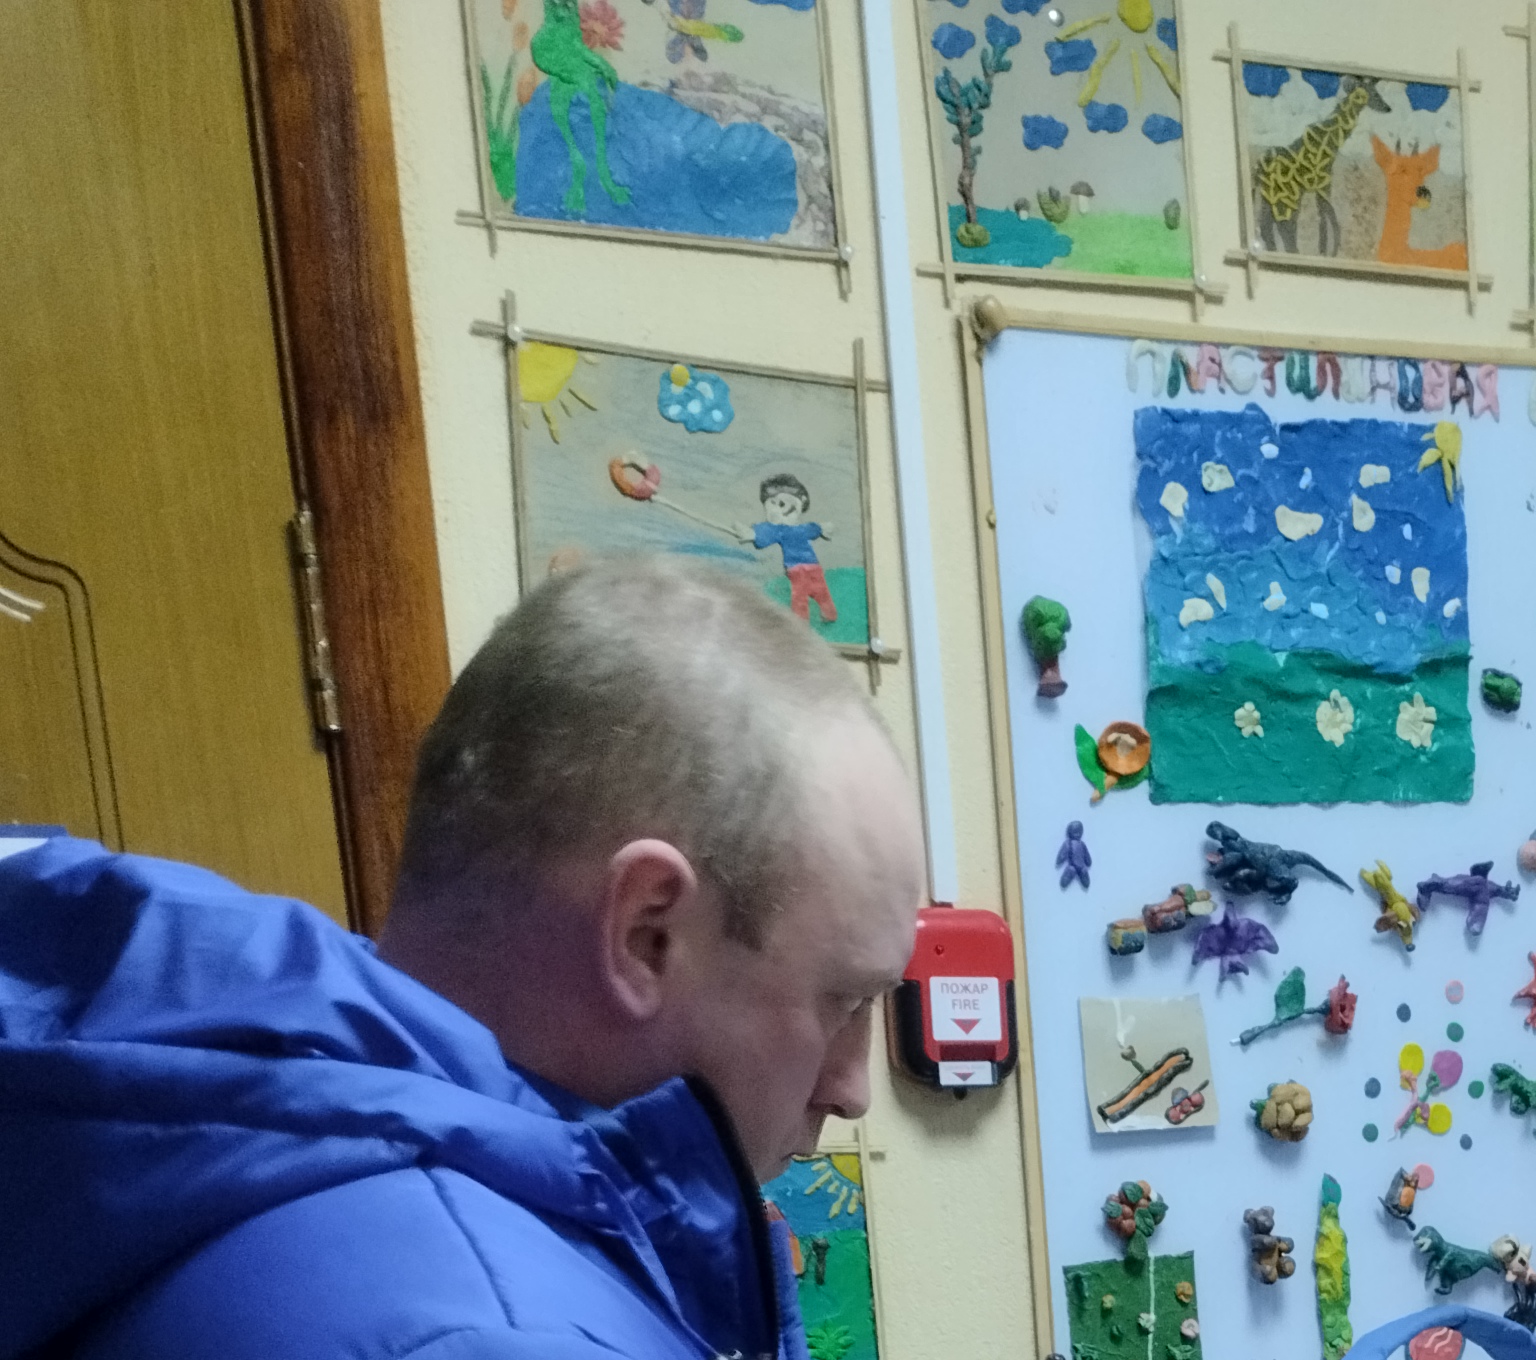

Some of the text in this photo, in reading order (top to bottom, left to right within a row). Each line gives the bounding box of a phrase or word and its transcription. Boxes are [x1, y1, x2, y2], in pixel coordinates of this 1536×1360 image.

[1125, 338, 1499, 423] ПЛАСТИЛИНОВАЯ
[940, 982, 989, 995] ПОЖАР
[951, 999, 980, 1011] FIRE
